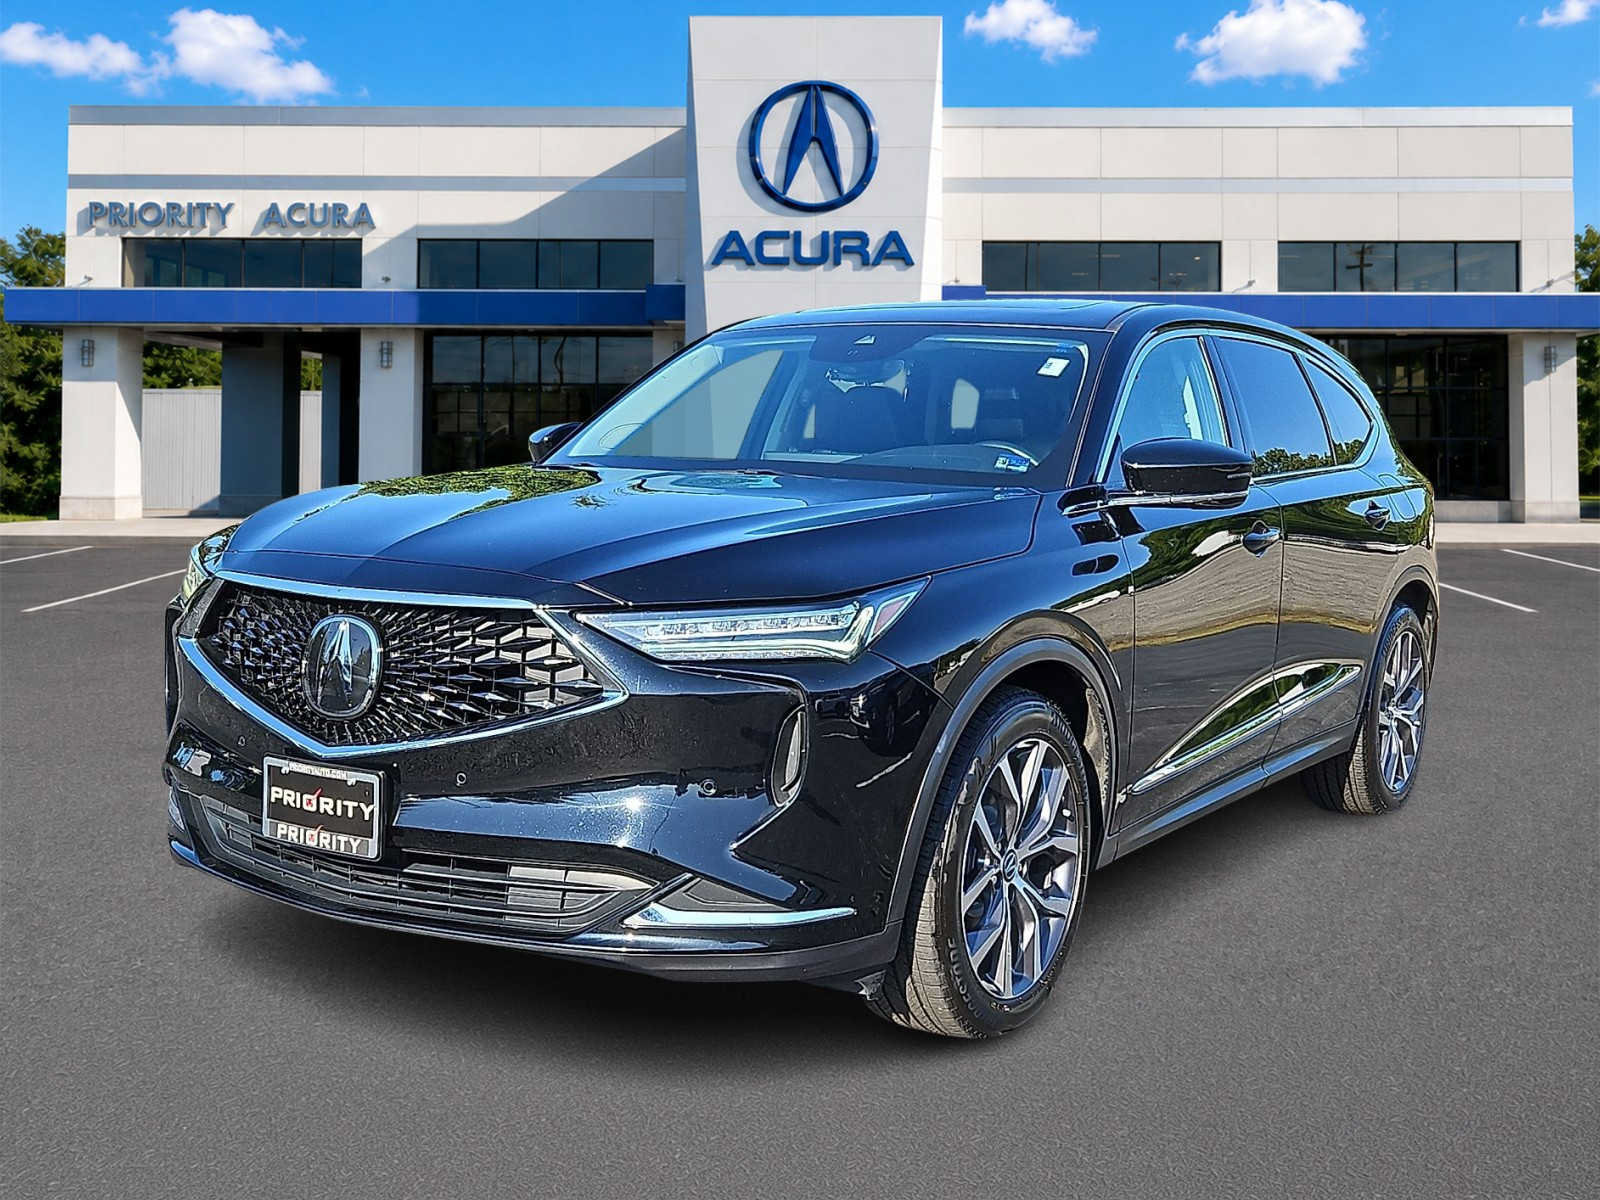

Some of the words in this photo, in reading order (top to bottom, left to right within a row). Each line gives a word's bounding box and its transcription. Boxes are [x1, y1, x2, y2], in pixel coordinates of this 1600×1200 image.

[88, 201, 234, 228] PRIORITY
[263, 202, 376, 229] ACURA
[711, 230, 915, 266] ACURA
[270, 786, 374, 821] PRIORITY
[276, 823, 362, 854] PRIORITY
